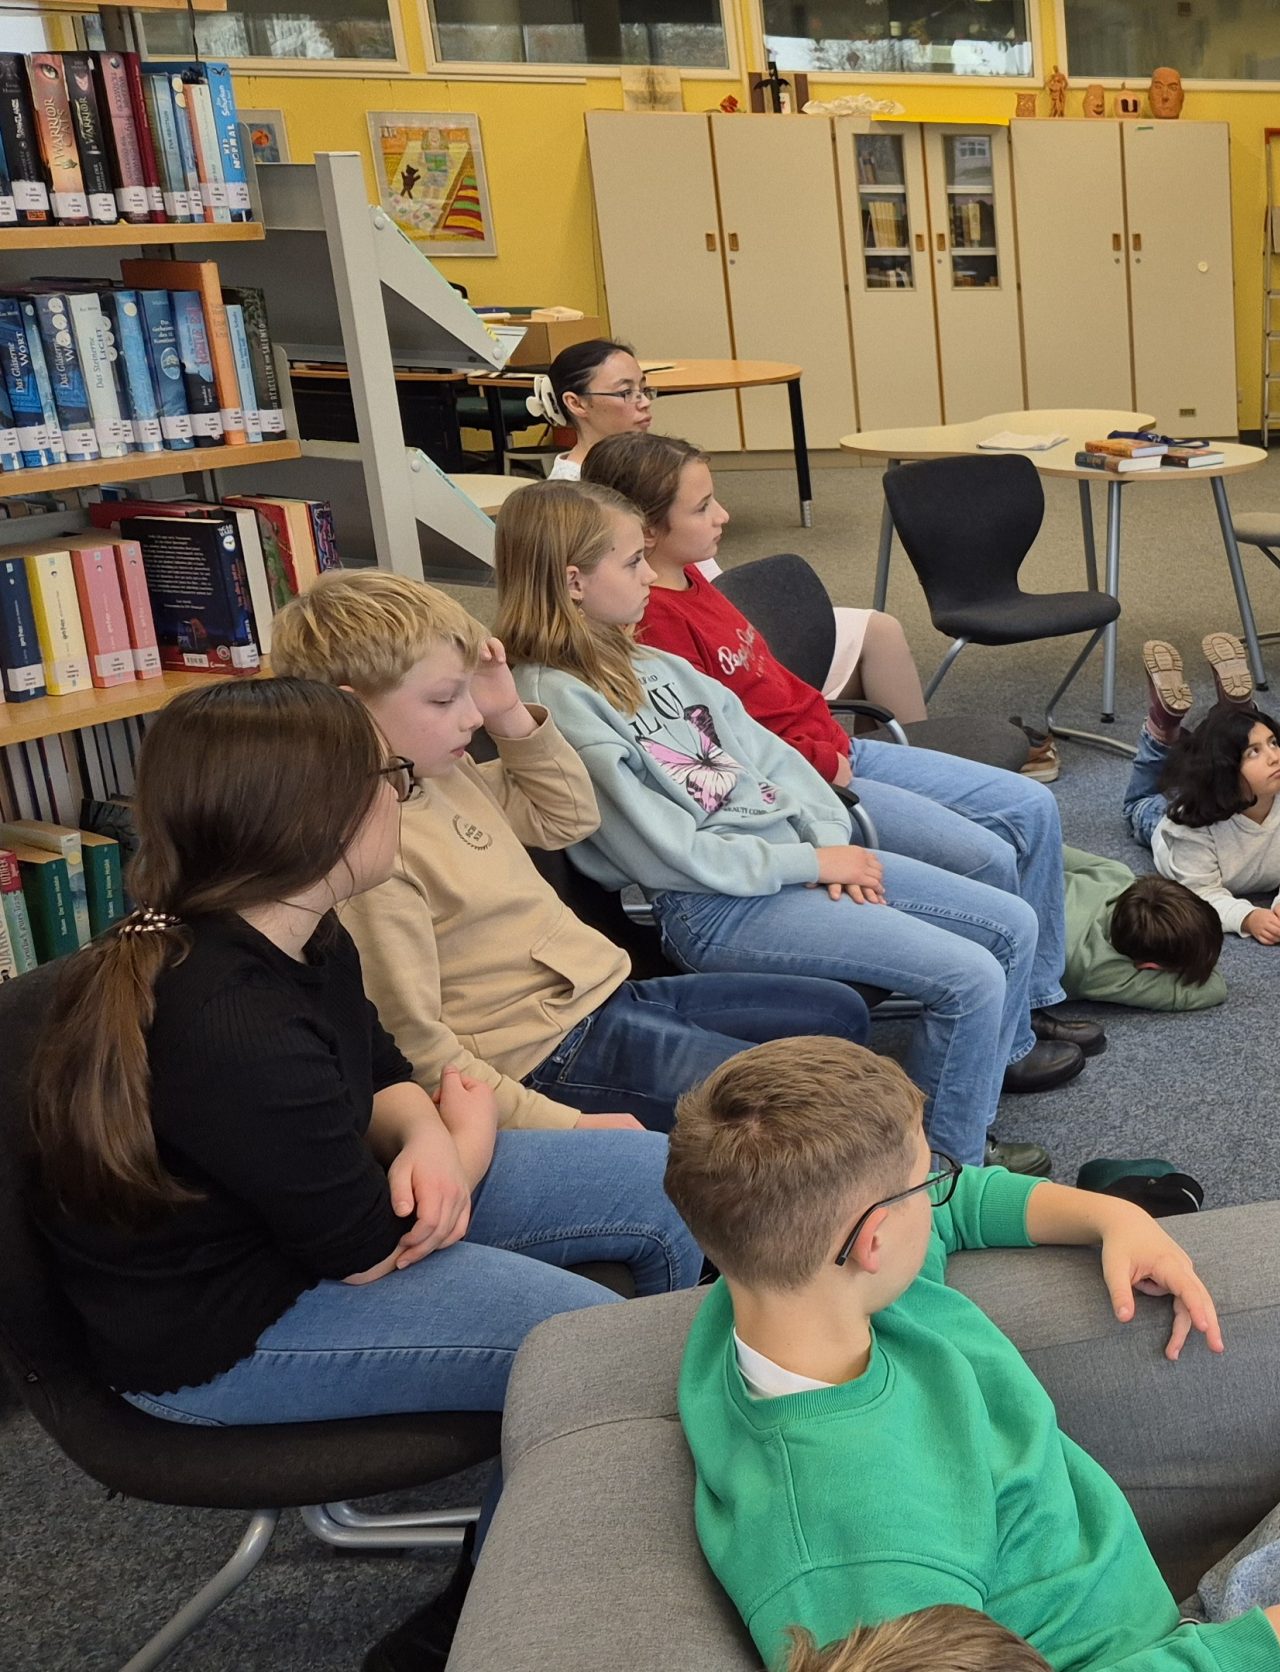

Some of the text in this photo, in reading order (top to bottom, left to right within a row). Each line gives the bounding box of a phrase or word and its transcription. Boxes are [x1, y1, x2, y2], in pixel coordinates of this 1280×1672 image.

[47, 96, 66, 160] WARRIOR
[229, 123, 241, 169] NORMAL
[18, 331, 30, 366] WORT
[97, 328, 107, 361] LICHT
[10, 342, 25, 393] Das Gläserne
[58, 374, 69, 388] Das
[96, 374, 105, 388] Das
[266, 364, 278, 401] REBELLEN
